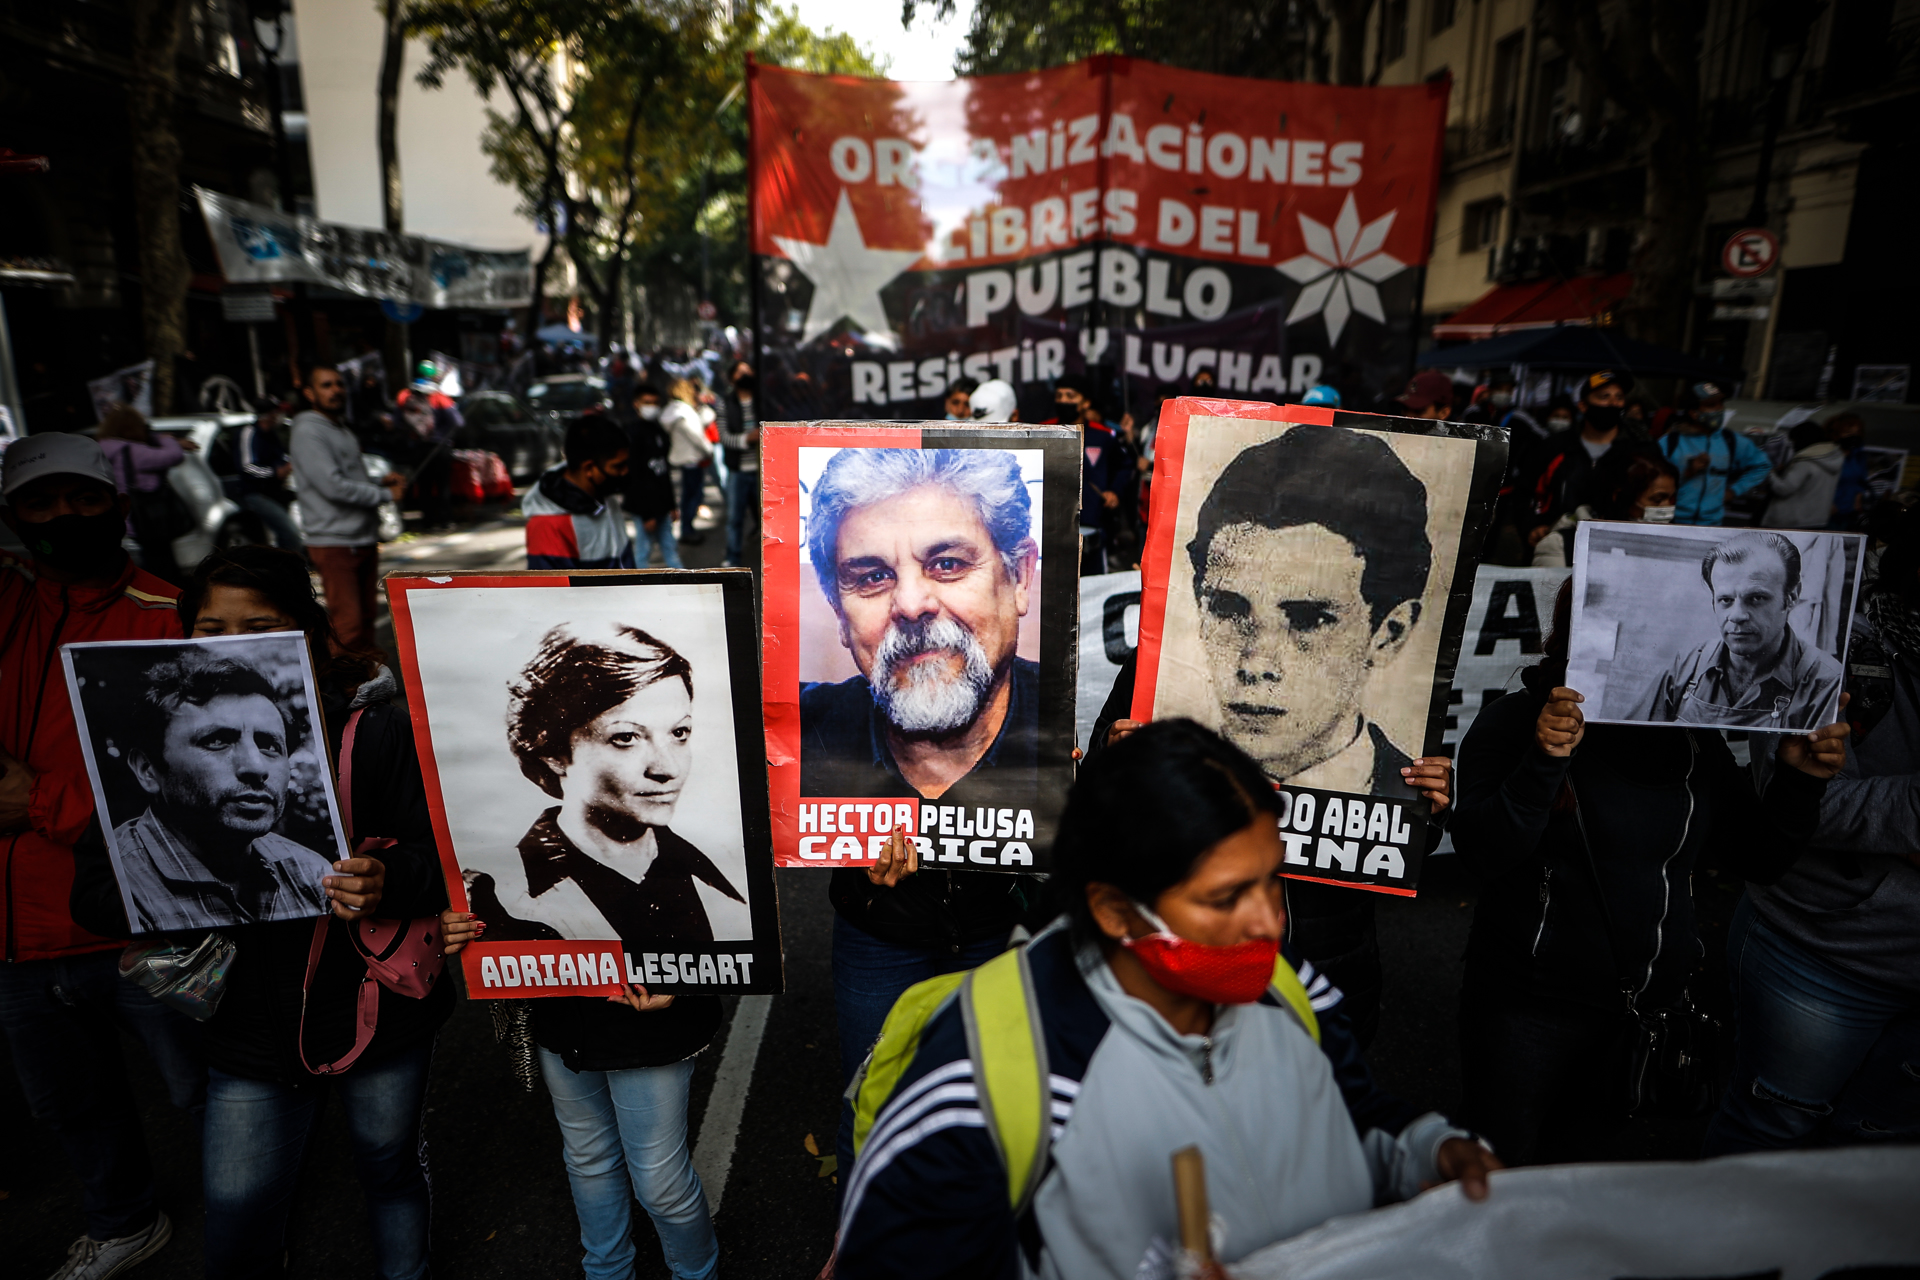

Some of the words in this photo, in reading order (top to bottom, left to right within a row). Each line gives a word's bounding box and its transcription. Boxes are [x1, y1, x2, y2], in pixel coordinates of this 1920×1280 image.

[1157, 199, 1268, 259] DEL
[965, 247, 1233, 328] PUEBLO
[1079, 325, 1110, 364] Y
[1125, 335, 1324, 395] LUCHAR
[798, 803, 914, 833] HECTOR
[920, 804, 1035, 839] PELUSA
[1321, 797, 1411, 845] ABAL
[480, 952, 620, 988] ADRIANA
[624, 953, 754, 984] LESGART
